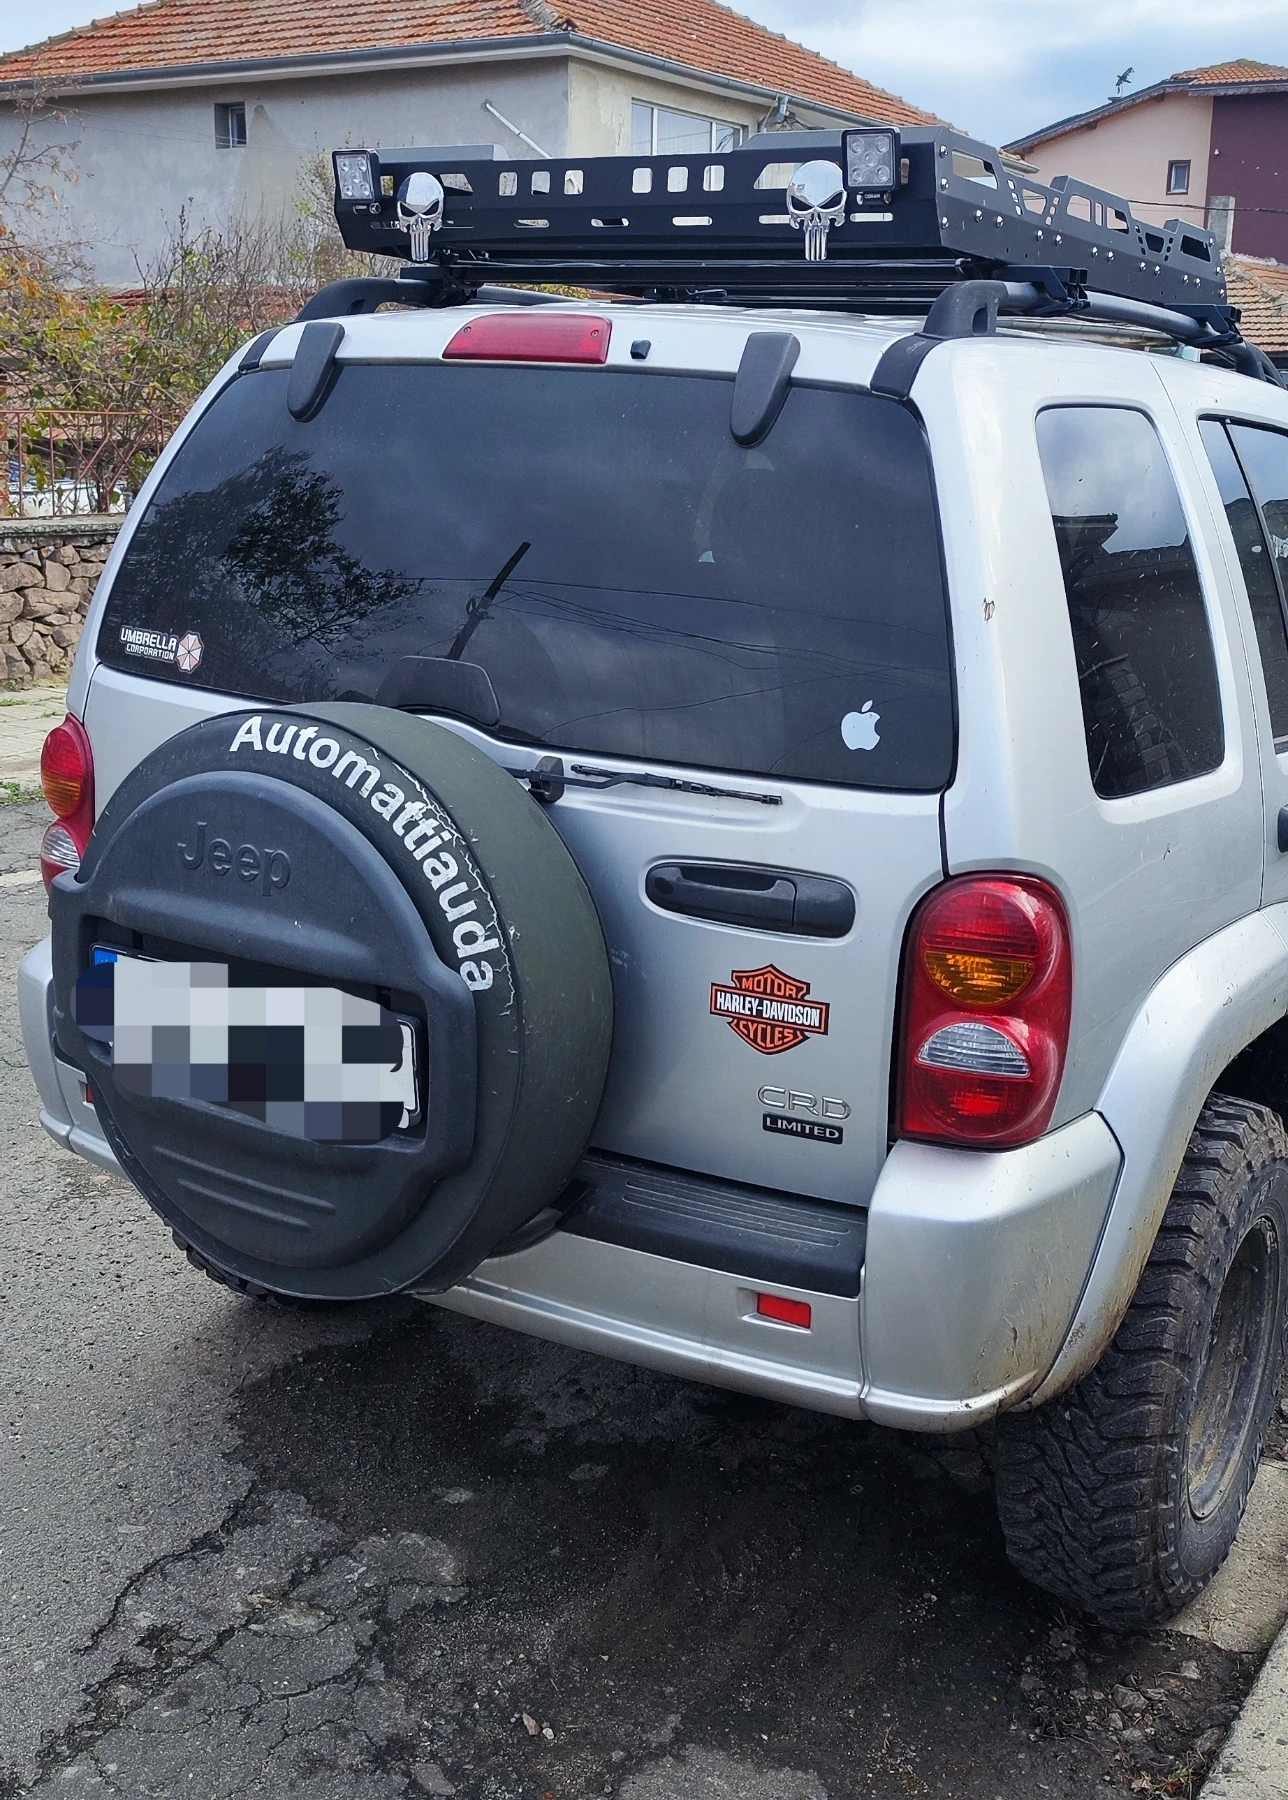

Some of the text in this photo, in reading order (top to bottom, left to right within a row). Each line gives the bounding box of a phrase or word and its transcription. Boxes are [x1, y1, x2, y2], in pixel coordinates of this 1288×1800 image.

[120, 627, 178, 652] UMBRELLA
[126, 643, 175, 661] CORPORATION
[177, 821, 291, 897] Jeep
[741, 973, 797, 999] MOTOR
[716, 991, 820, 1027] HARLEY-DAVIDSON
[739, 1020, 794, 1048] CYCLES
[757, 1084, 852, 1120] CRD
[766, 1116, 840, 1139] LIMITED
